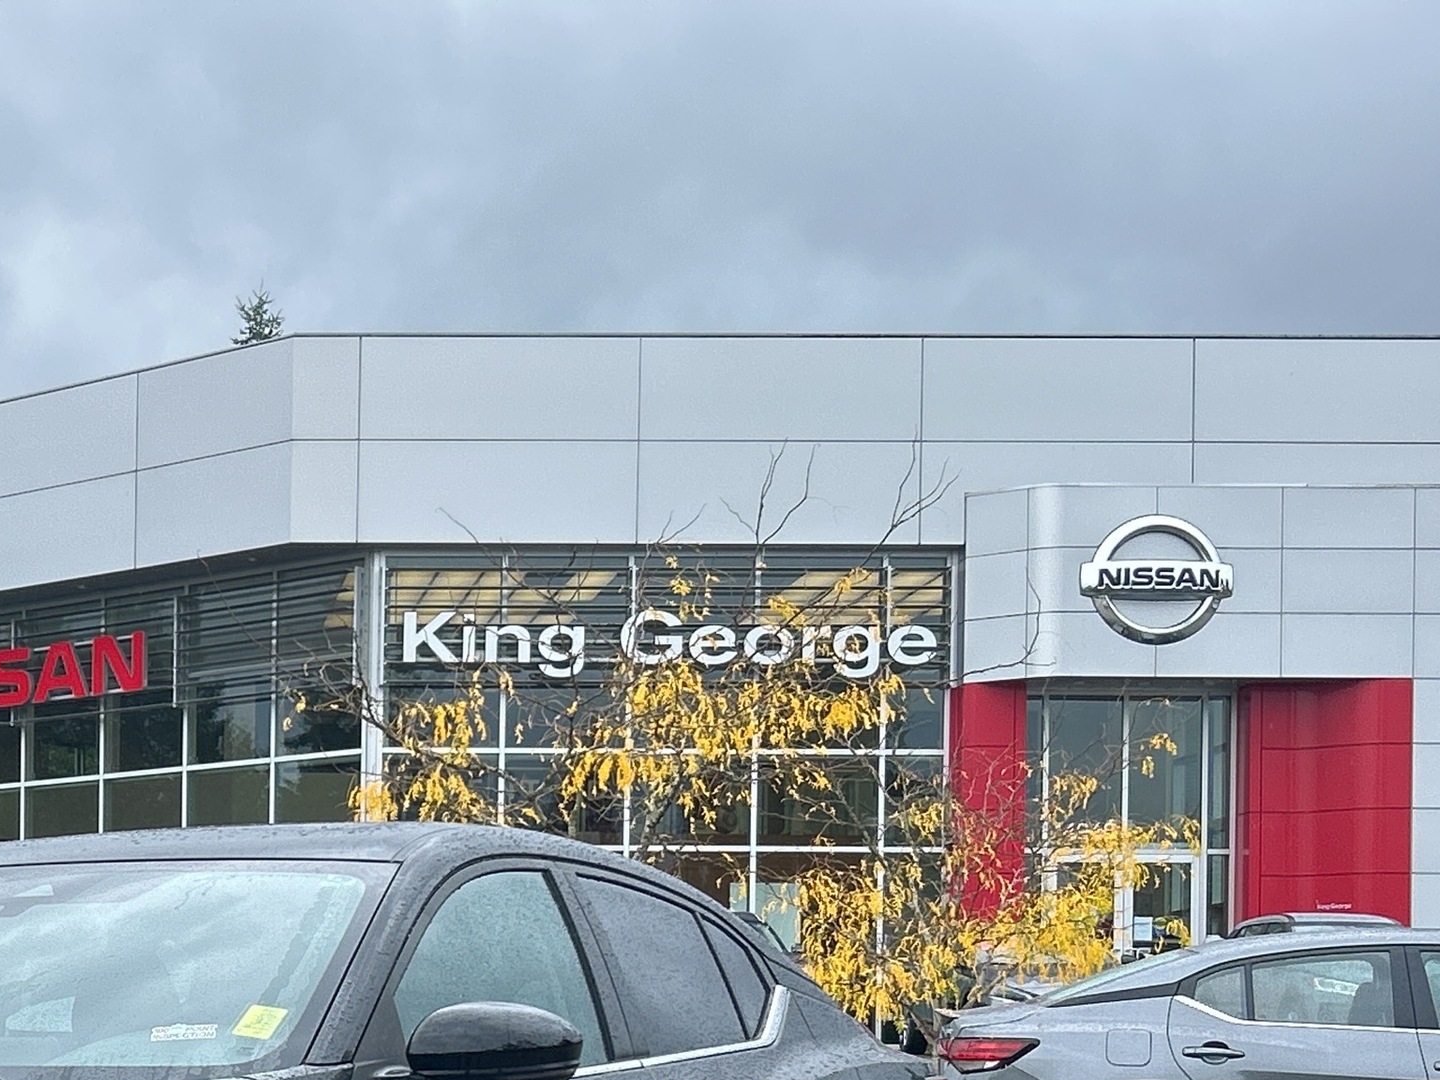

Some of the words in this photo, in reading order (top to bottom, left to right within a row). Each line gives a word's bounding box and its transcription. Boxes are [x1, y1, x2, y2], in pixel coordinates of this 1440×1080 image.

[1098, 567, 1220, 588] NISSAN
[403, 611, 584, 678] King
[620, 610, 937, 678] George
